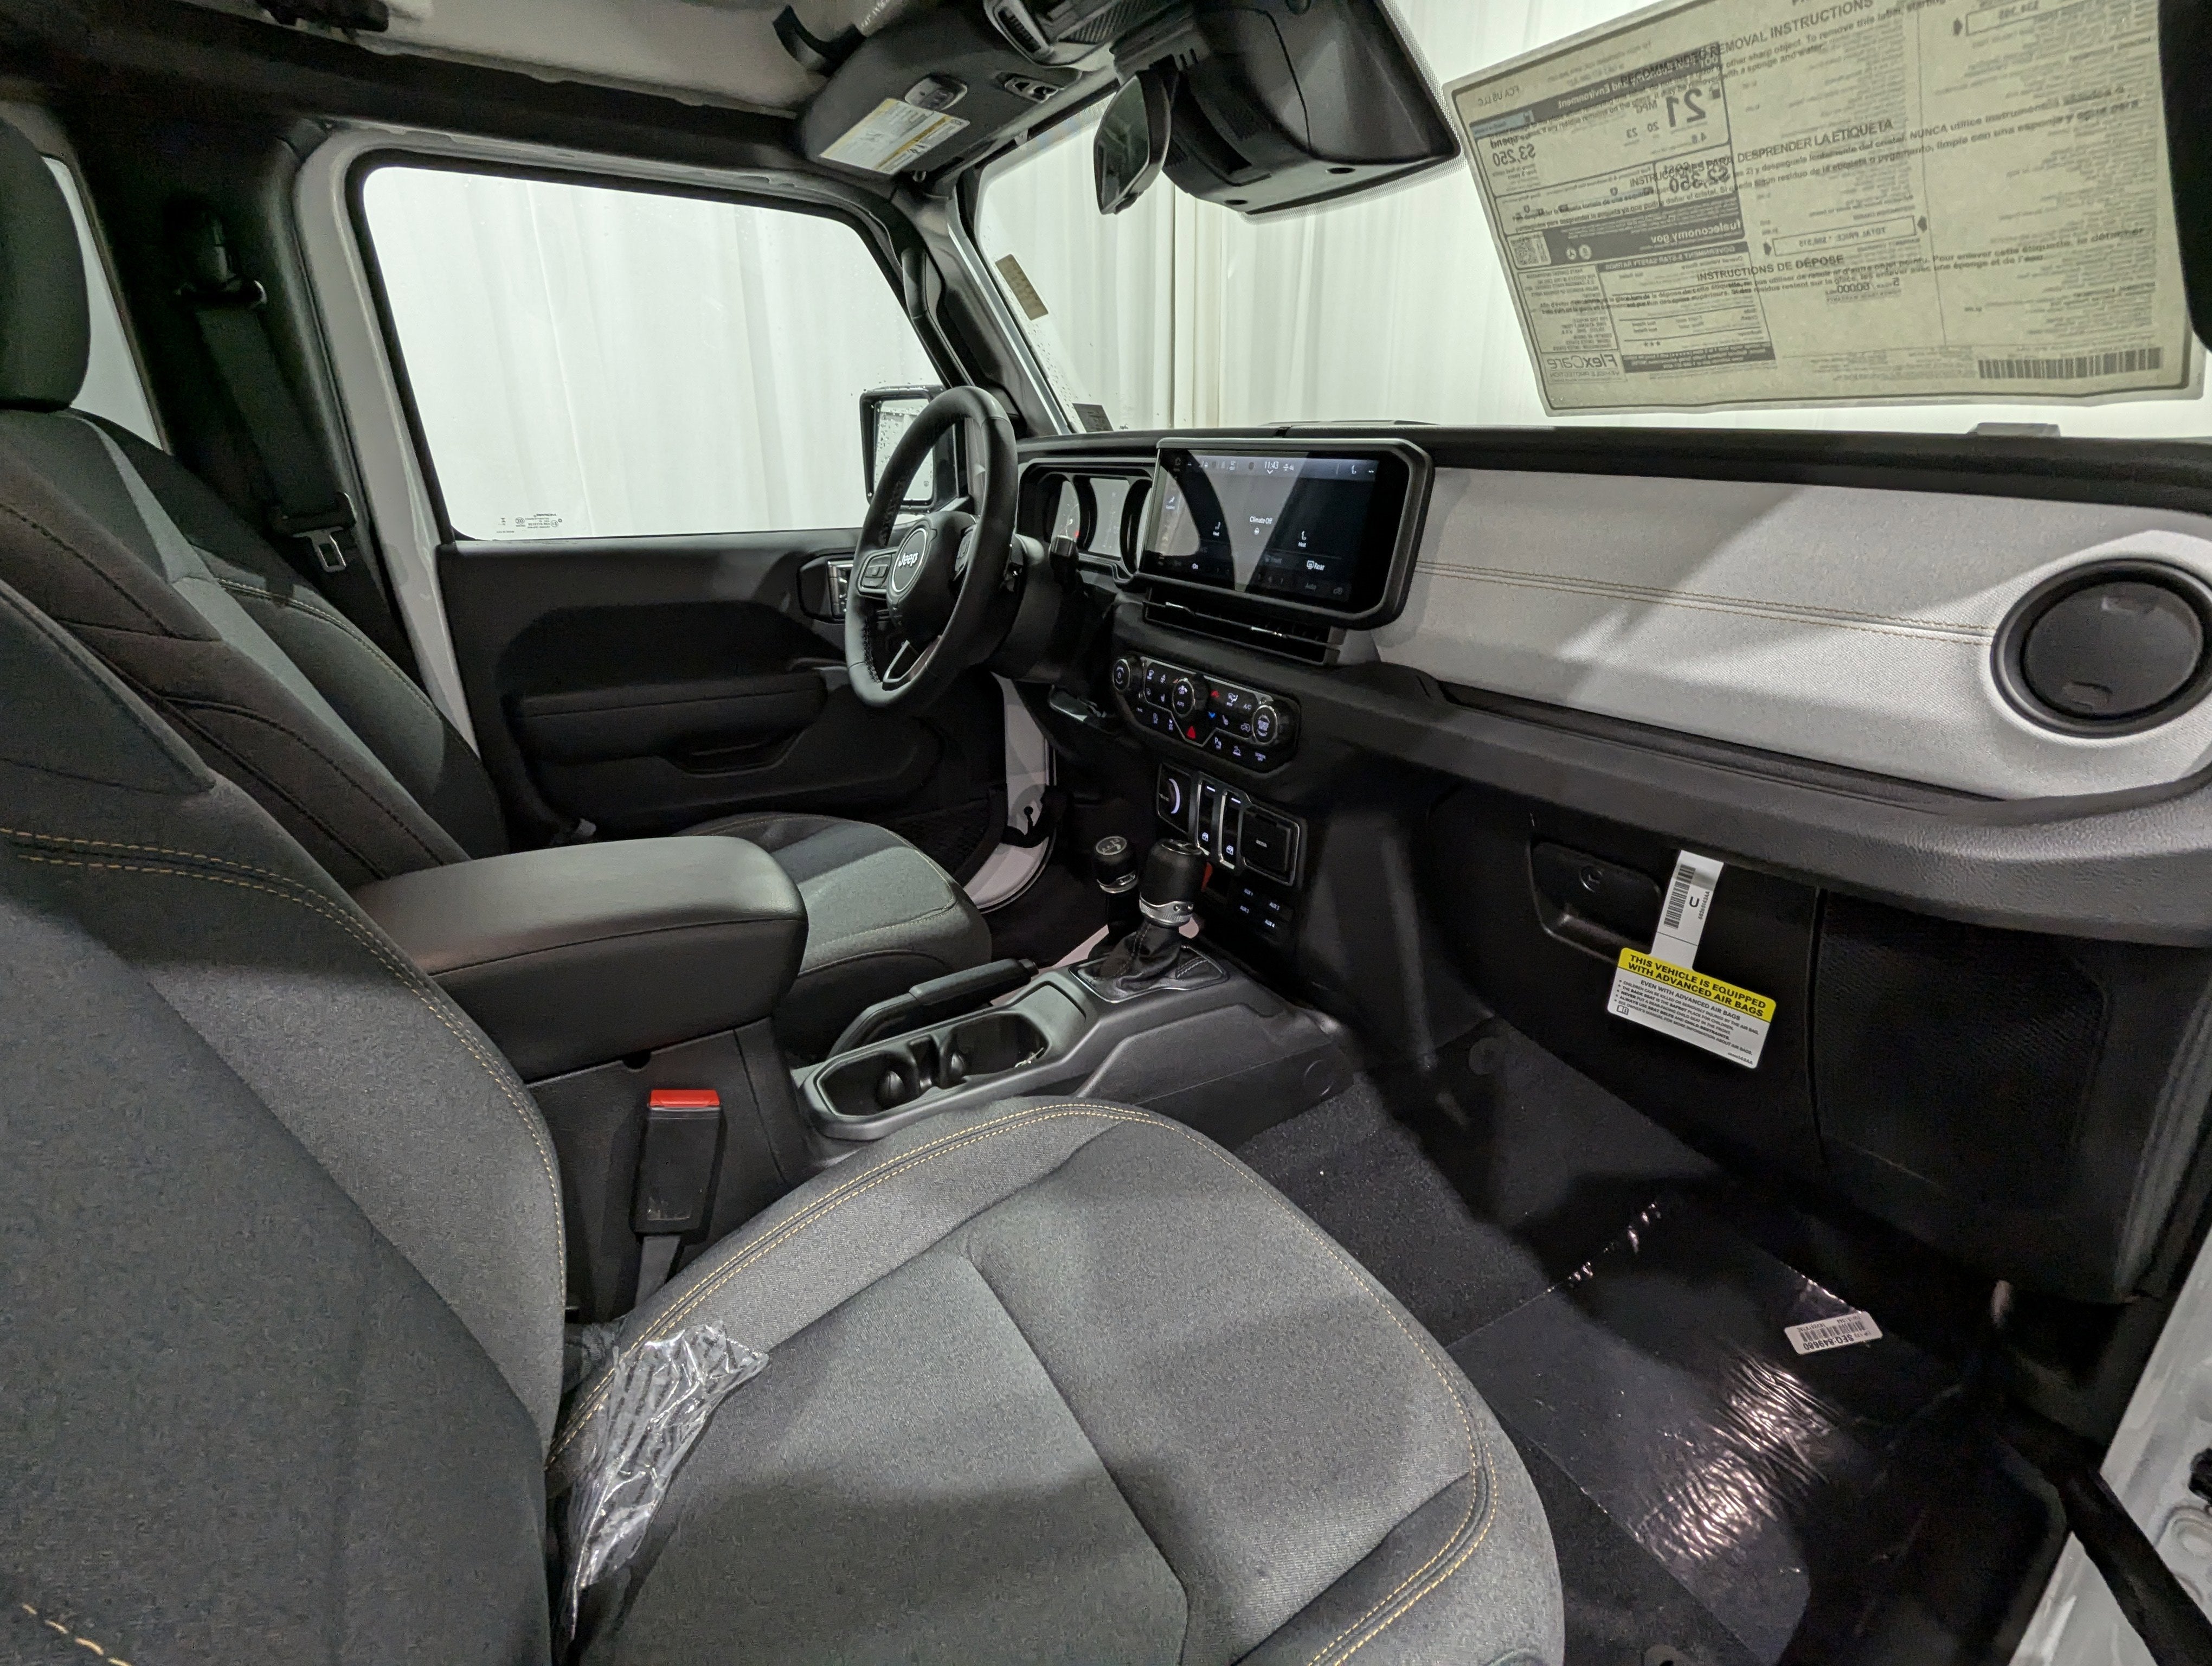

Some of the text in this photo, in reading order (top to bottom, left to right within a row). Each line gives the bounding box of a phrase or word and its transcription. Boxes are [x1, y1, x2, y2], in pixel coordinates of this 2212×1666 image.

[1709, 0, 1873, 57] REMOVAL INSTRUCTIONS
[1819, 24, 1854, 40] remove
[1747, 57, 1777, 73] sponge
[1910, 124, 1948, 140] NUNCA
[1738, 137, 1812, 163] DESPRENDER
[1815, 131, 1832, 145] LA
[1831, 118, 1893, 142] ETIQUETA
[1697, 264, 1774, 281] INSTRUCTIONS
[1777, 262, 1792, 272] DE
[1264, 461, 1279, 470] 11:43
[1250, 516, 1265, 524] Climate
[898, 552, 918, 568] Jeep
[1314, 562, 1324, 571] Rear
[1689, 896, 1700, 907] U
[1626, 962, 1764, 1017] WITH ADVANCED AIR BAGS
[1629, 954, 1767, 1009] THIS VEHICLE IS EQUIPPED
[1620, 990, 1636, 999] NEVER
[1623, 981, 1644, 991] CHILDREN
[1660, 994, 1674, 1002] KILLED
[1619, 996, 1638, 1005] ALWAYS
[1660, 1010, 1674, 1018] BELTS
[1626, 1003, 1645, 1013] OWNER'S
[1640, 980, 1741, 1021] EVEN WITH ADVANCED AIR BAGS
[1669, 1003, 1687, 1012] SAFEST
